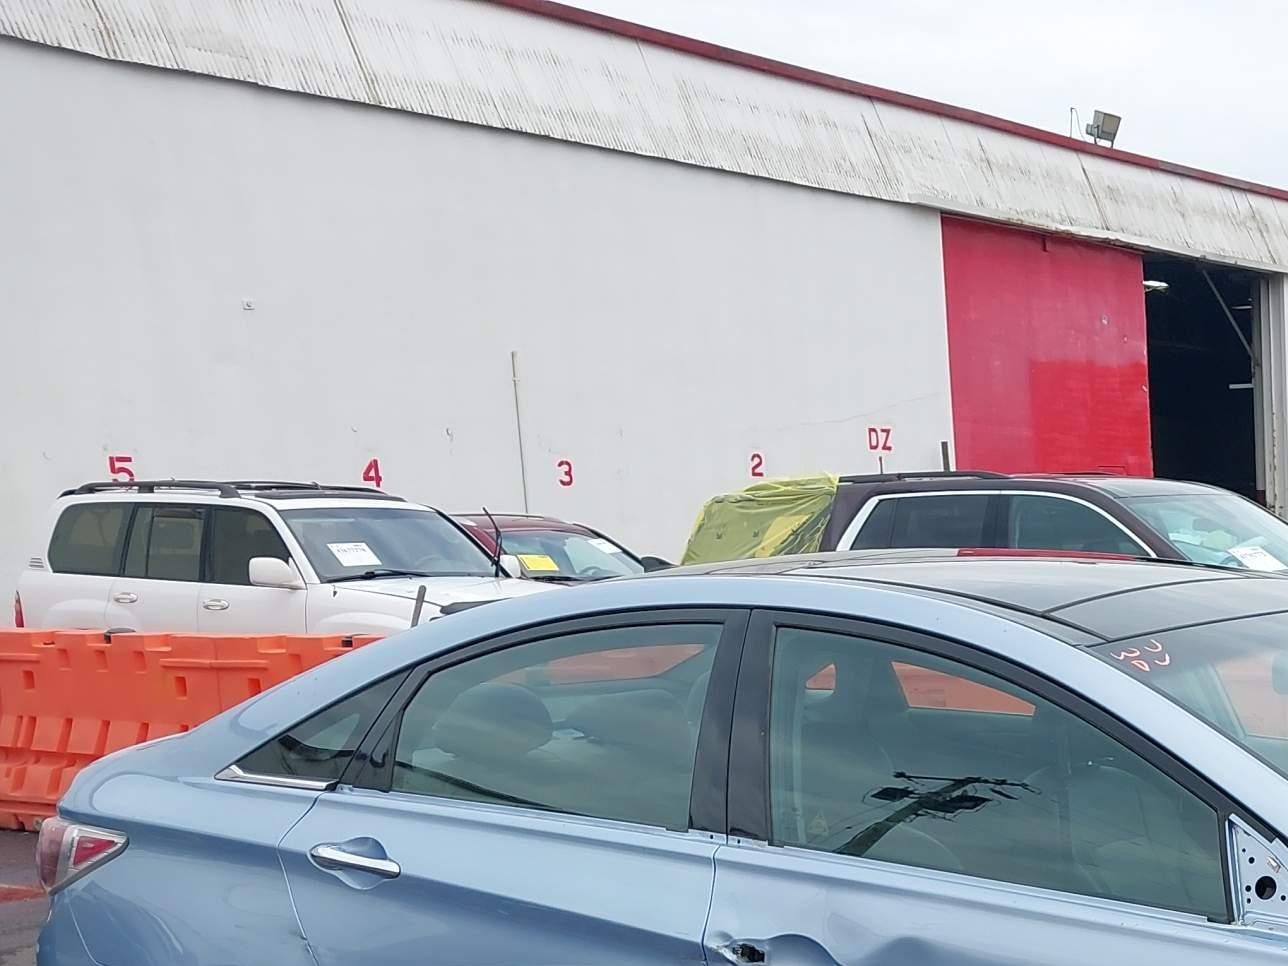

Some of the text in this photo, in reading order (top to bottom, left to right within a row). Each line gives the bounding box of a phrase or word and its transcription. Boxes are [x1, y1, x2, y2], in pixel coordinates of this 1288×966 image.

[868, 427, 893, 452] DZ
[108, 456, 136, 487] 5
[362, 458, 383, 488] 4
[557, 460, 574, 487] 3
[750, 453, 764, 477] 2
